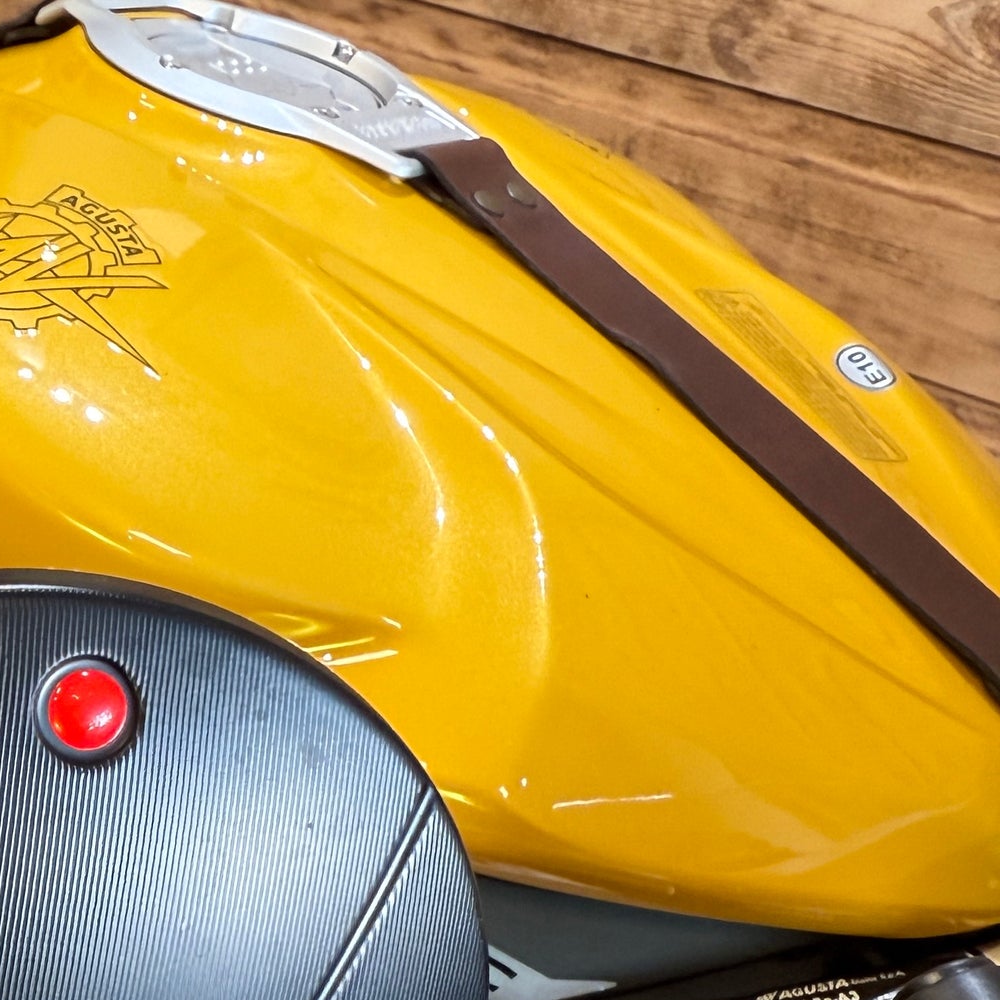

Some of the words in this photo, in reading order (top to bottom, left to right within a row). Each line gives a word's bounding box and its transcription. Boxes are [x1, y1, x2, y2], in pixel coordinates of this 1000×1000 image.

[60, 194, 144, 259] AGUSTA
[847, 350, 887, 385] E10
[779, 978, 849, 1000] AGUSTA
